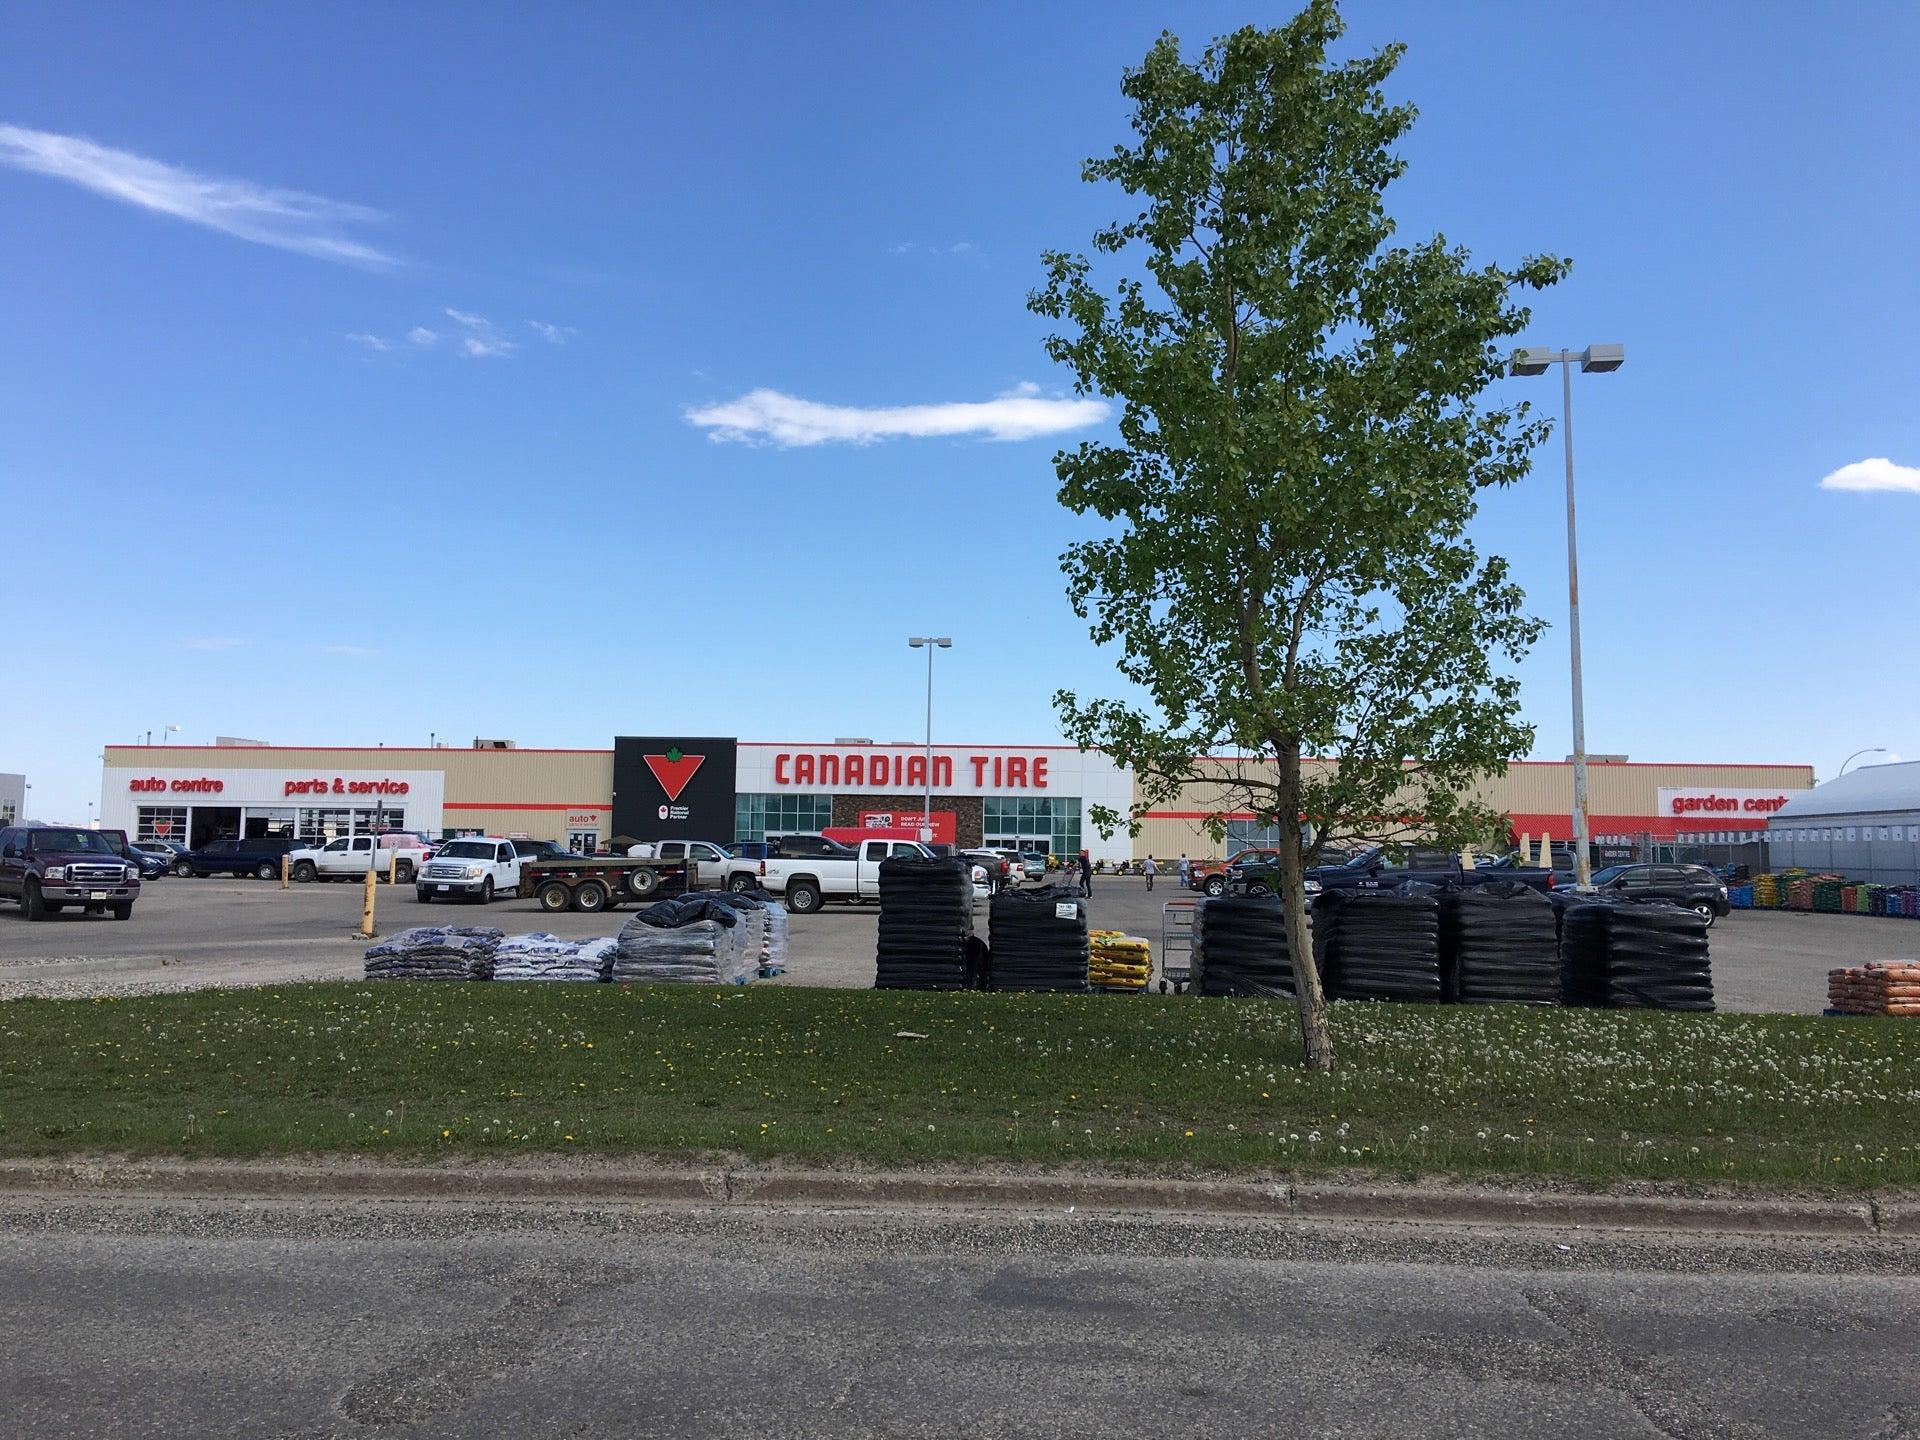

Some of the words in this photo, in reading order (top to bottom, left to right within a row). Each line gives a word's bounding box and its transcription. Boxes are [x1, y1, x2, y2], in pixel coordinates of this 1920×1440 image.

[775, 754, 953, 787] CANADIAN
[970, 756, 1048, 788] TIRE
[129, 776, 167, 792] auto
[170, 777, 224, 792] centre
[284, 778, 329, 797] parts
[332, 777, 345, 794] &
[348, 778, 409, 795] service
[1672, 794, 1739, 814] garden
[1743, 796, 1790, 812] cent
[569, 815, 589, 823] auto
